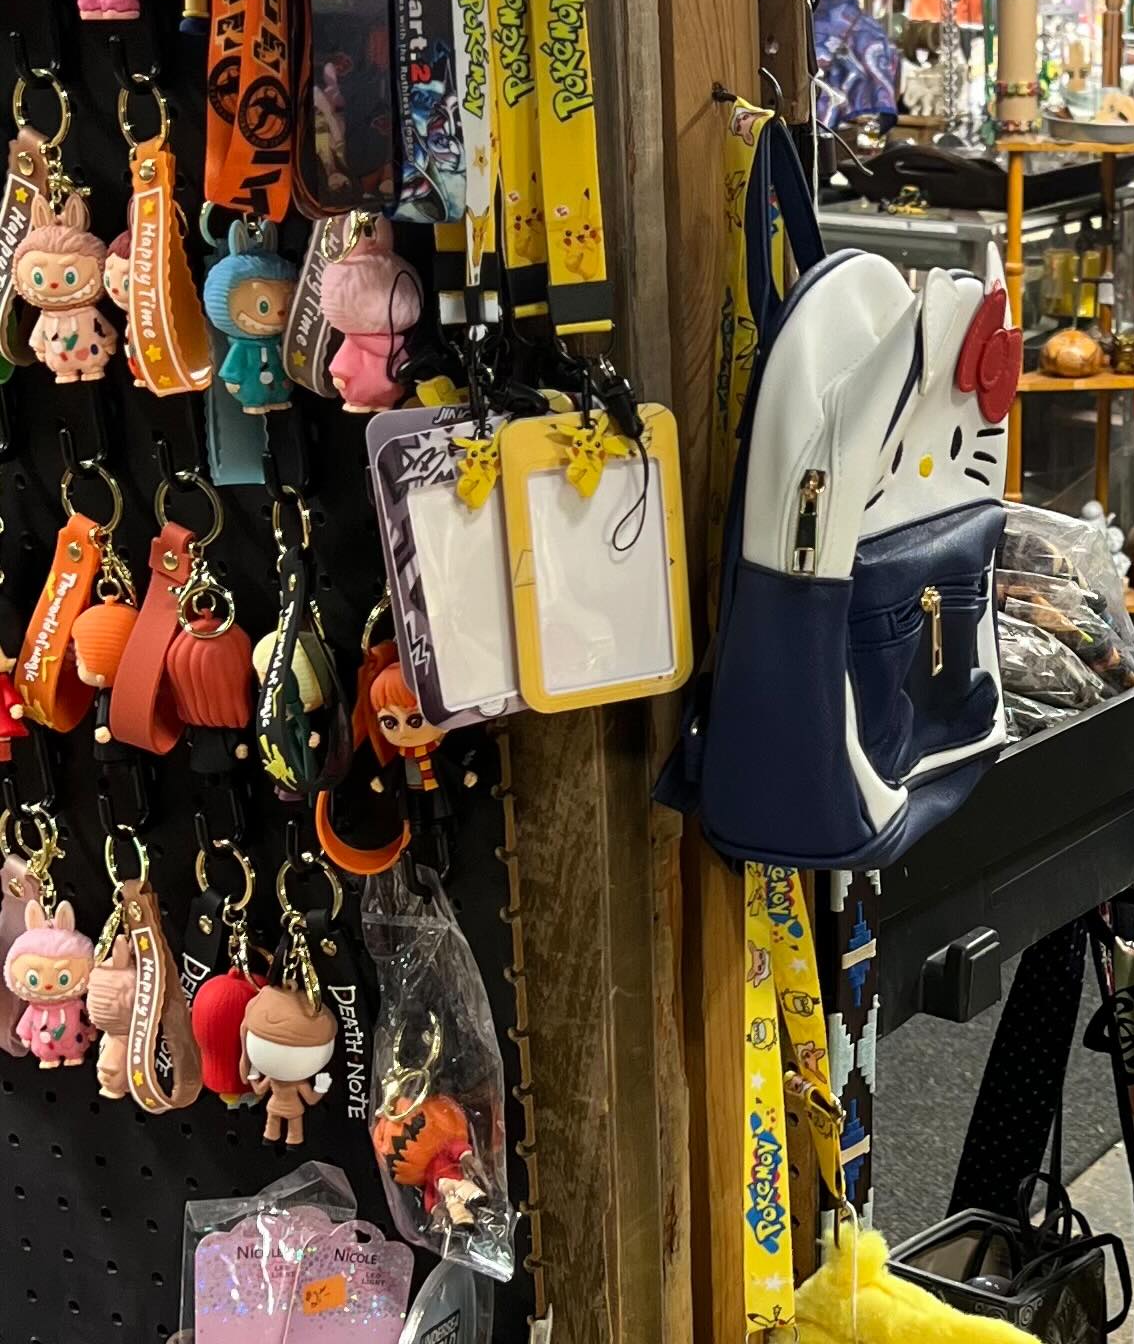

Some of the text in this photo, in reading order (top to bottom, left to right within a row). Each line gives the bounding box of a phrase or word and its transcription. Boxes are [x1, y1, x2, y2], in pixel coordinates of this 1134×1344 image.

[134, 223, 158, 339] Happy Time
[23, 572, 77, 682] The world of magic
[132, 957, 154, 1065] Happy Time
[327, 985, 369, 1120] DEATH NOTE
[236, 1246, 284, 1260] NICLE
[333, 1248, 378, 1265] NICOLE
[361, 1278, 386, 1286] LIGHT
